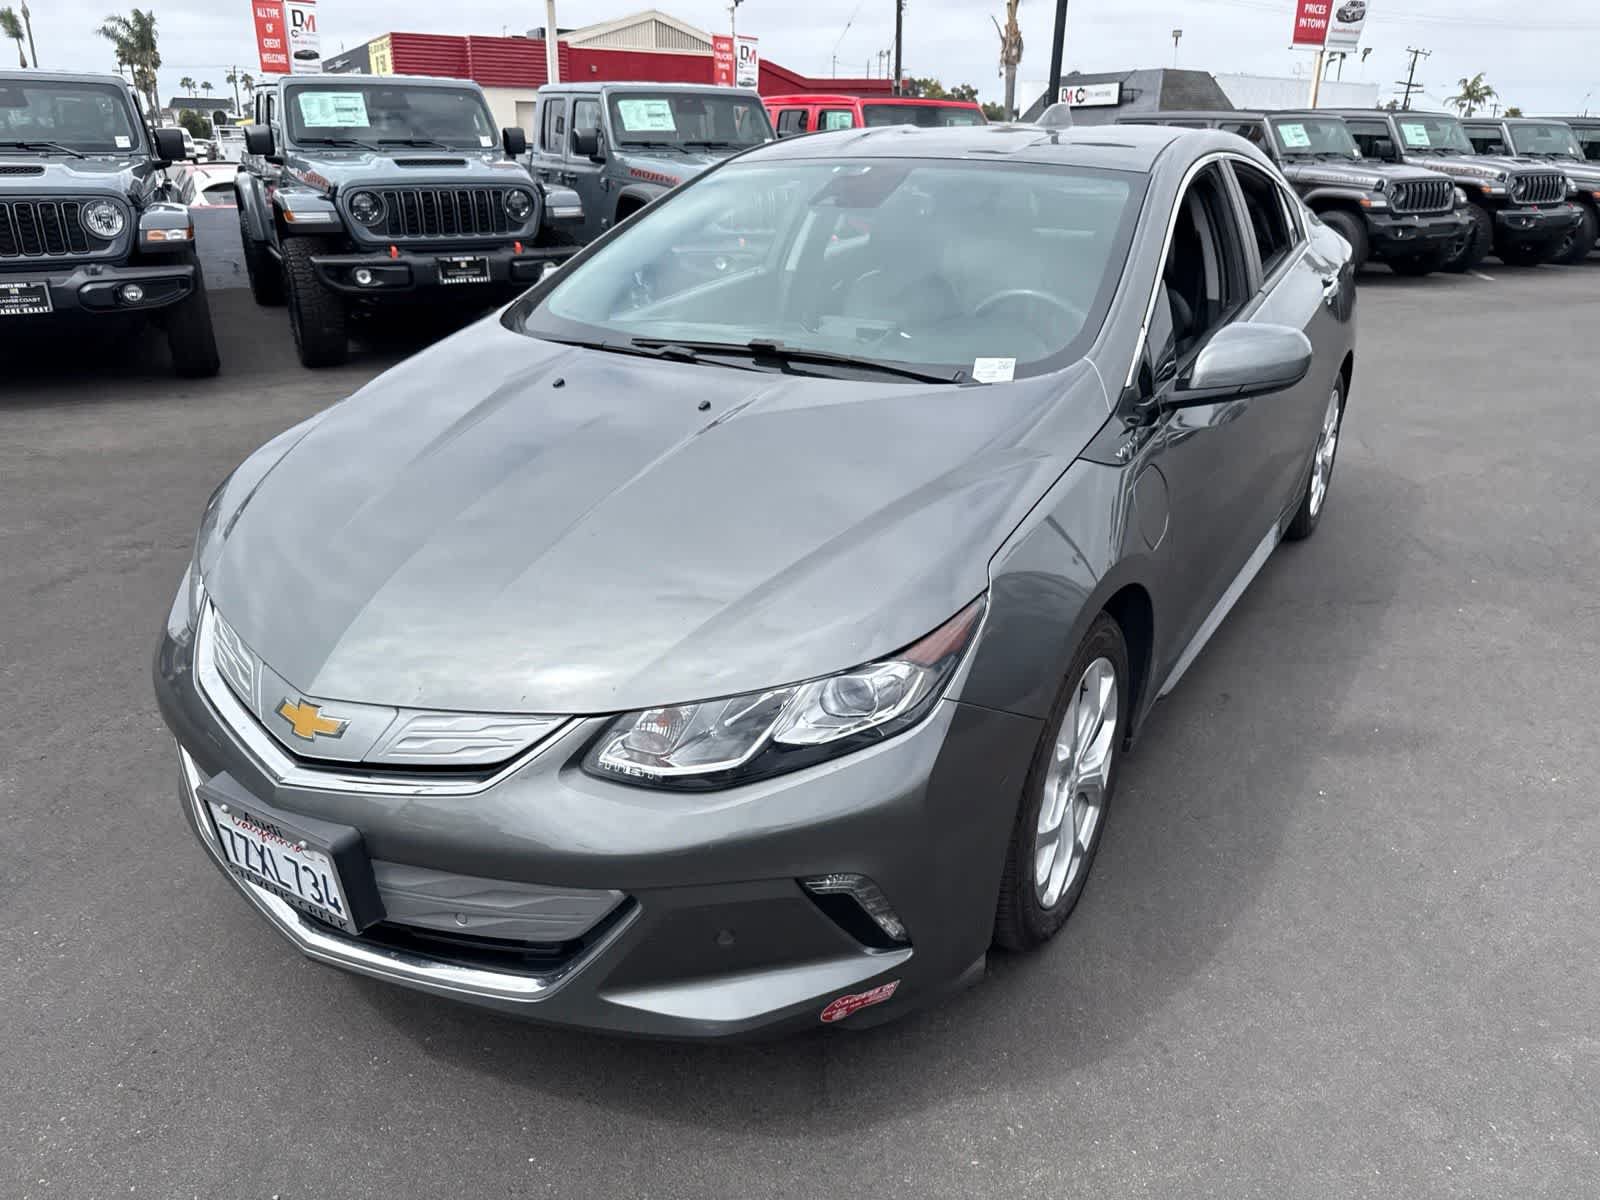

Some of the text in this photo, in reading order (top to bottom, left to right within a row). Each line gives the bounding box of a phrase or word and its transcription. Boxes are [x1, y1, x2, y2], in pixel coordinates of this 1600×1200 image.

[1304, 3, 1327, 14] PRICES
[1307, 18, 1326, 29] TOWN
[263, 38, 281, 49] CREDIT
[262, 53, 288, 64] WELCOME
[219, 822, 342, 914] 7ZXL734
